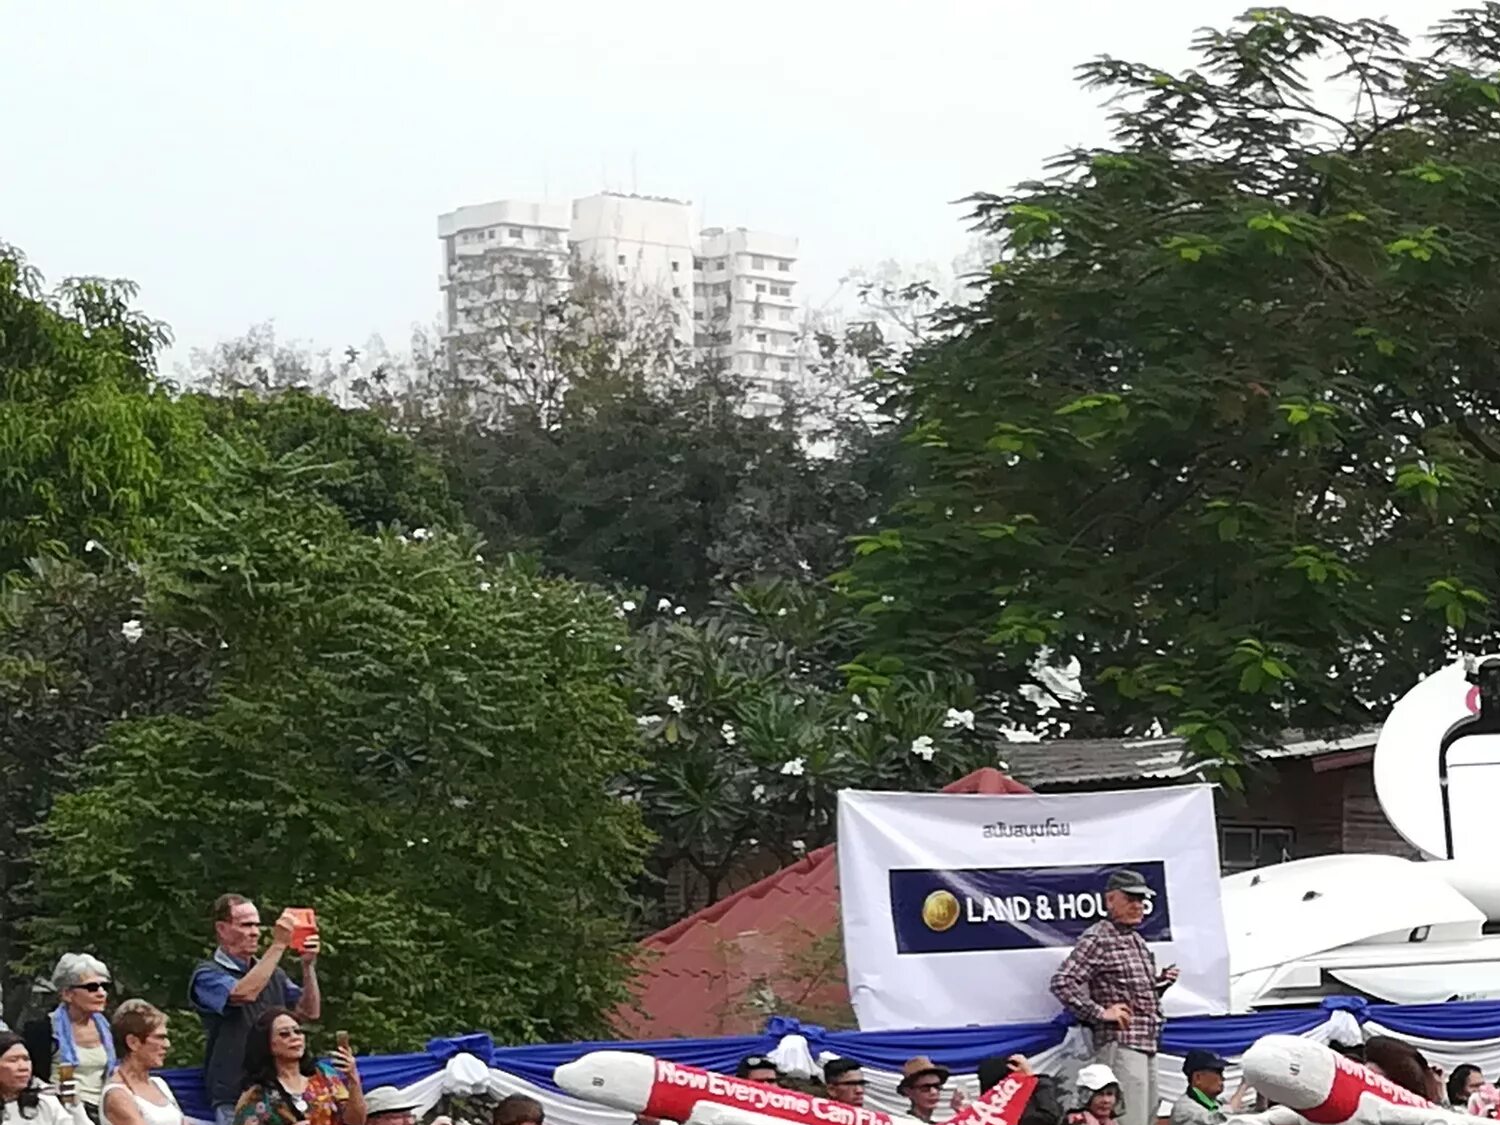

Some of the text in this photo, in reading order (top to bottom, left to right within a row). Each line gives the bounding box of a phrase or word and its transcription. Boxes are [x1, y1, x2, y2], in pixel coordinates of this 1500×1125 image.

[967, 895, 1031, 922] LAND
[1037, 895, 1055, 920] &
[1058, 892, 1153, 919] HOUS
[657, 1060, 708, 1090] Now
[707, 1071, 810, 1114] Everyone
[812, 1097, 855, 1125] Can
